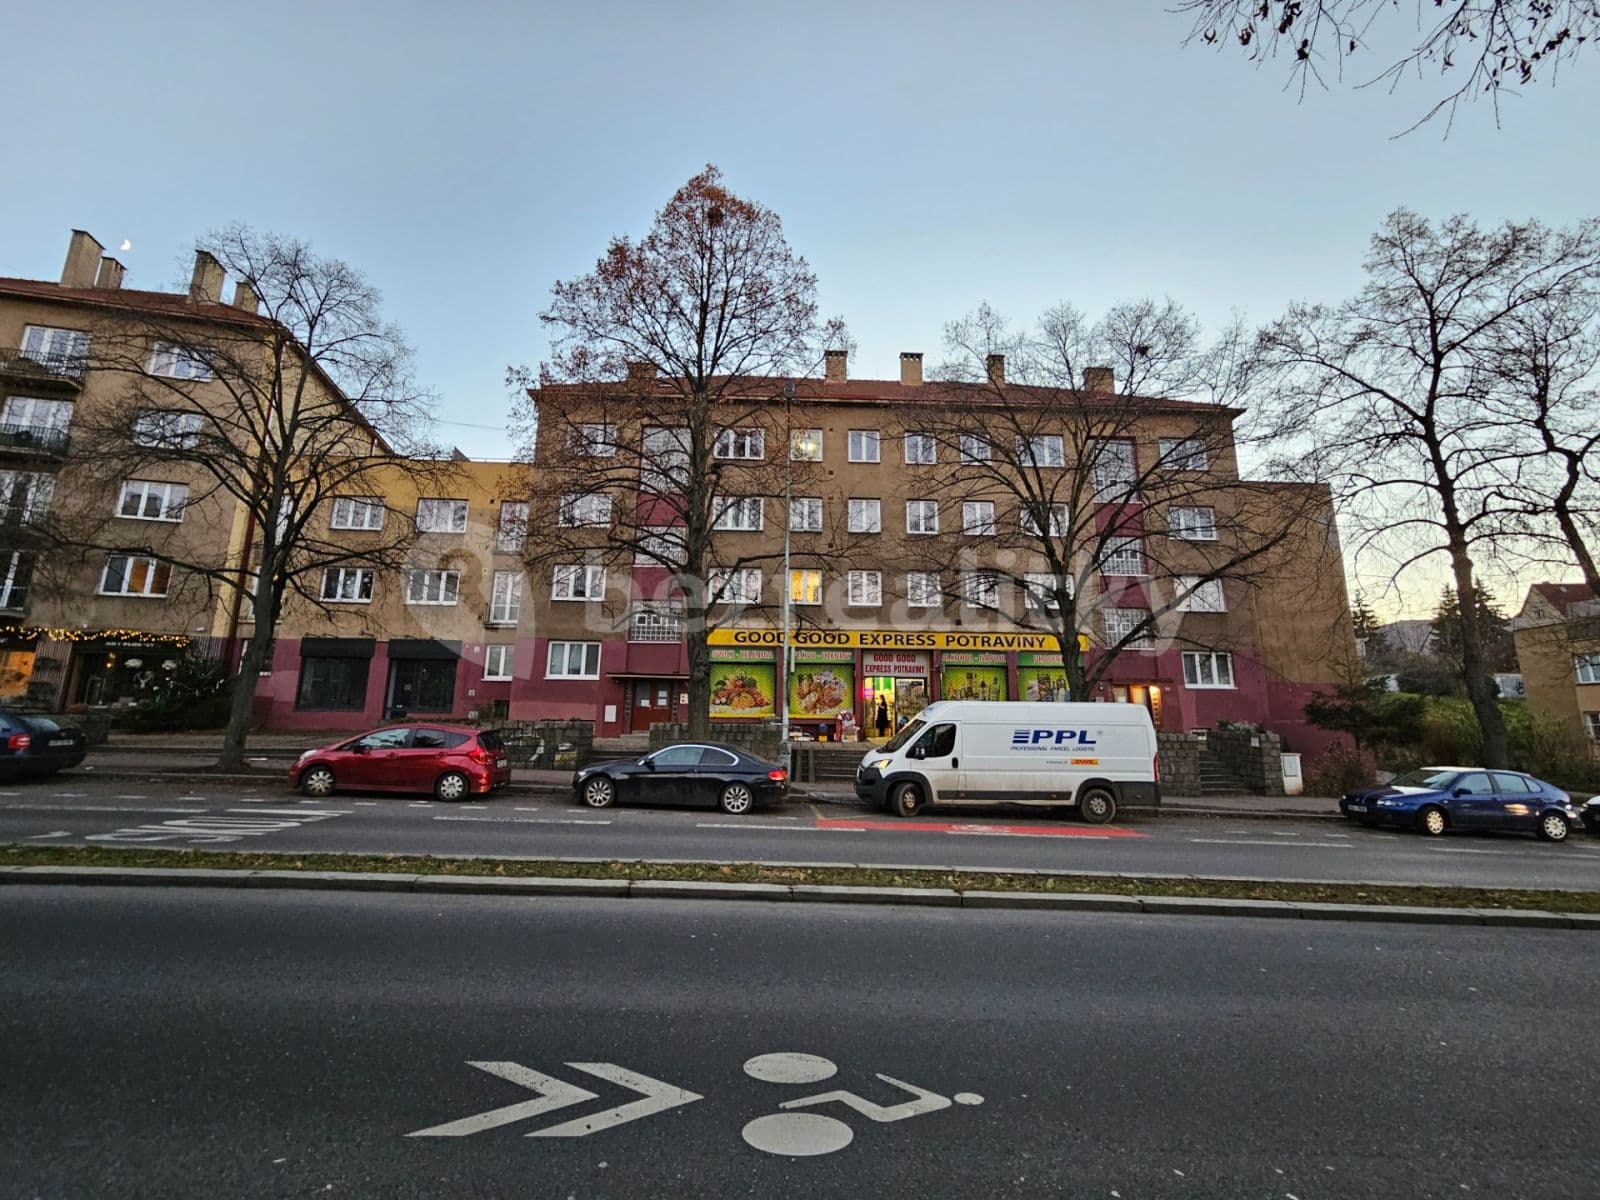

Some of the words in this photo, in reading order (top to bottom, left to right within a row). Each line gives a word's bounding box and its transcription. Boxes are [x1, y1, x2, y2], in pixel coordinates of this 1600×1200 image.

[734, 631, 785, 643] GOOD
[795, 632, 850, 644] GOOD
[860, 634, 936, 646] EXPRESS
[945, 635, 1046, 648] POTRAVINY
[873, 653, 893, 662] GOOD
[896, 654, 916, 663] GOOD
[865, 665, 892, 673] EXPRESS
[1031, 730, 1096, 744] PPL
